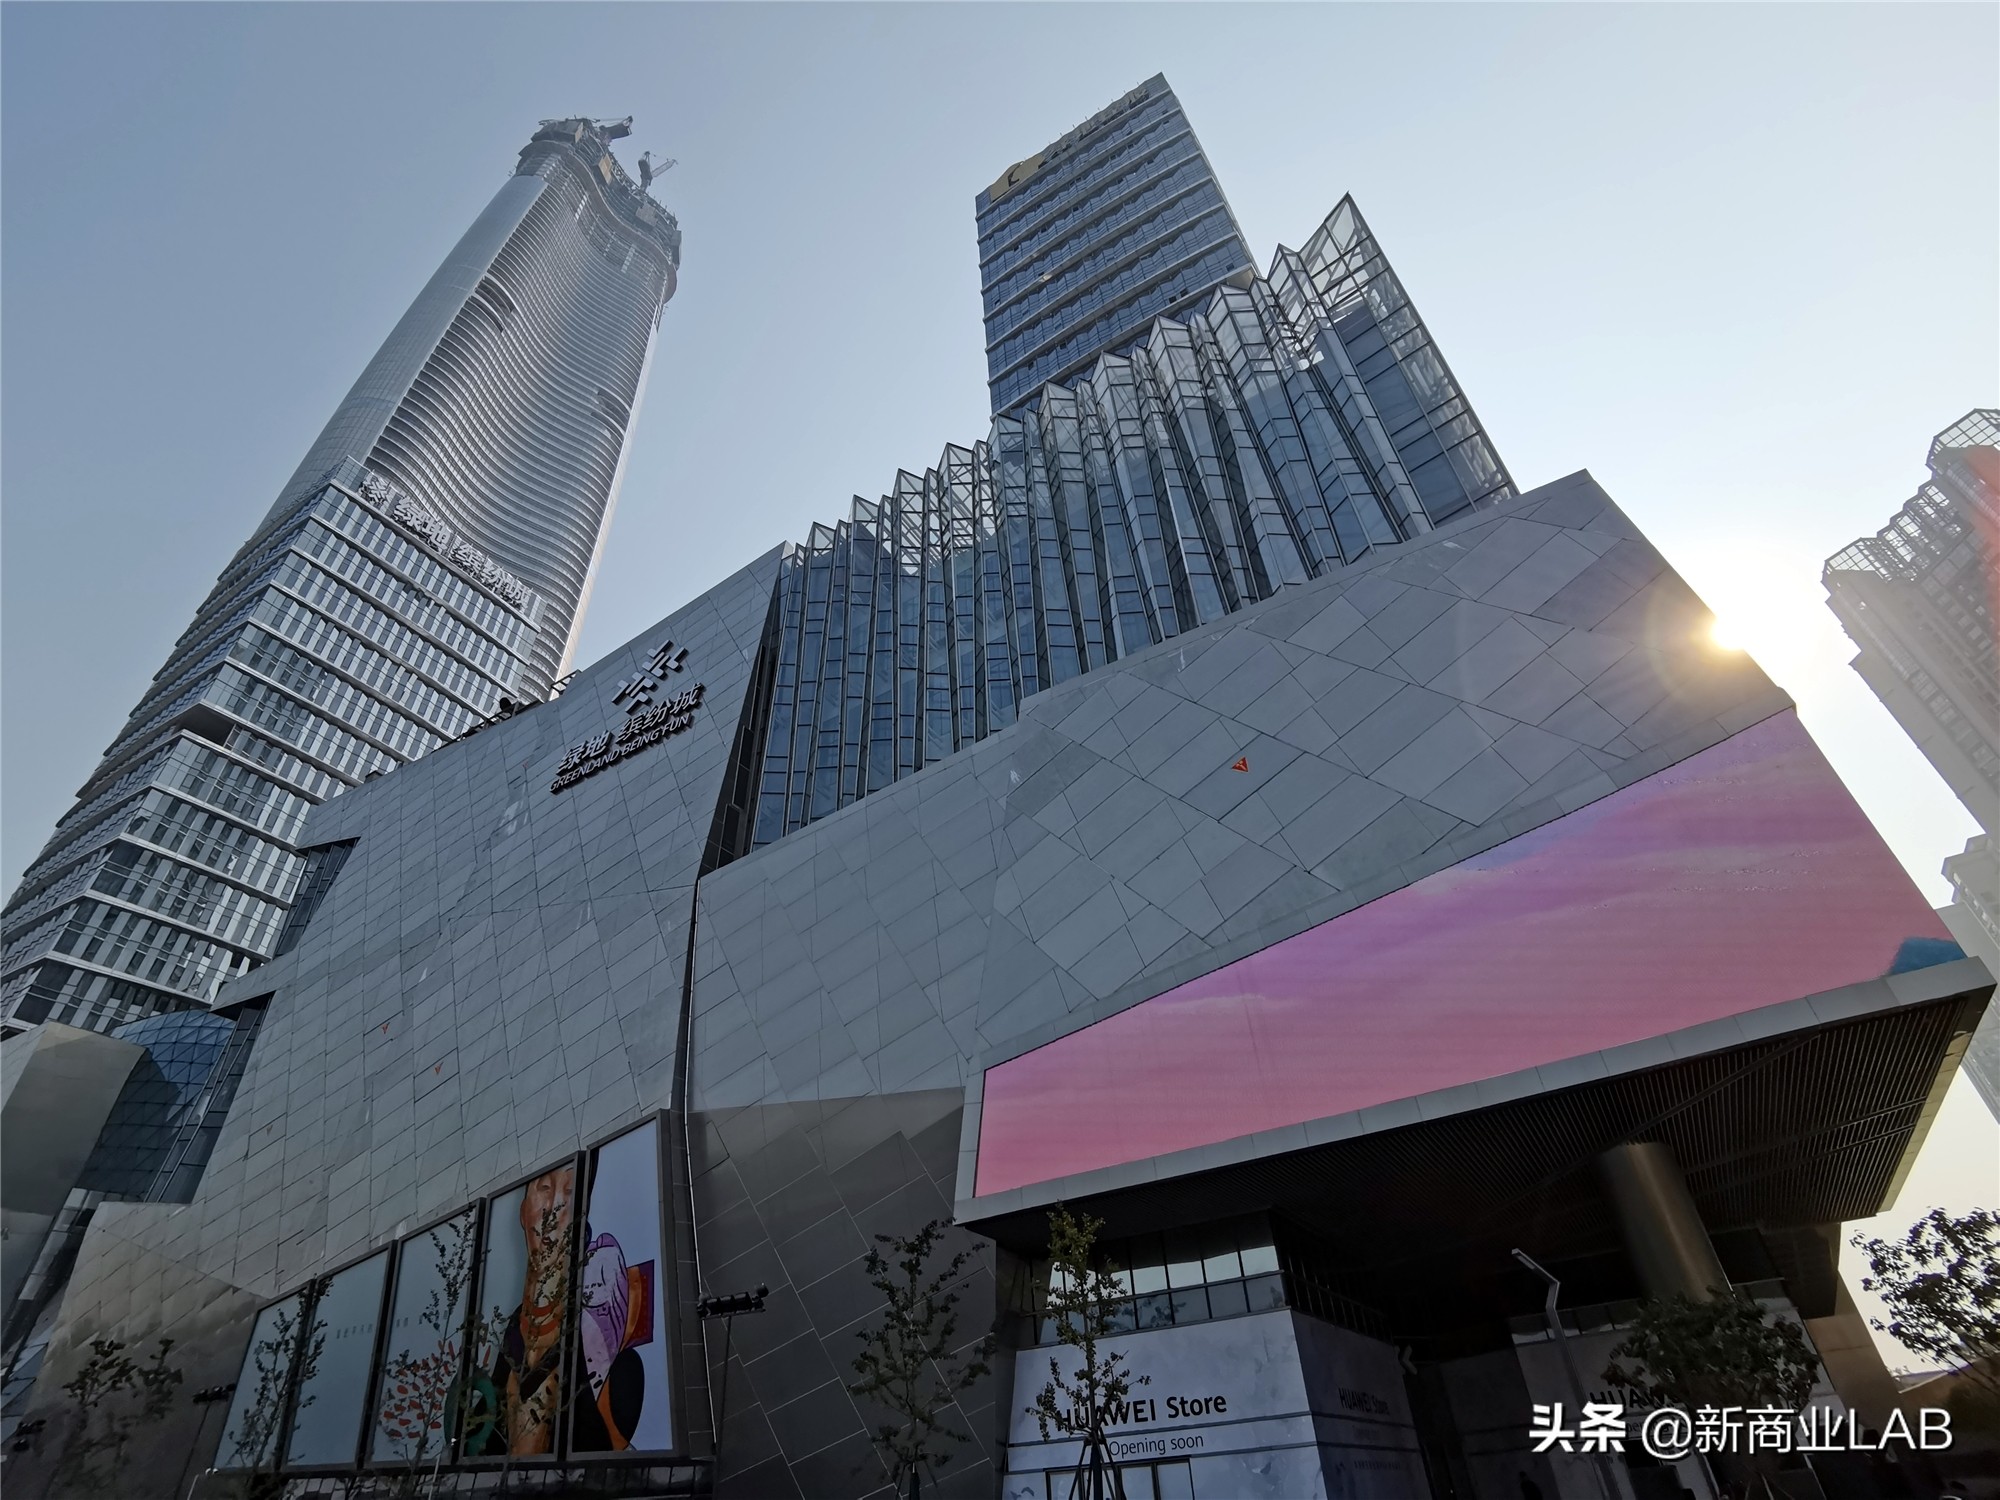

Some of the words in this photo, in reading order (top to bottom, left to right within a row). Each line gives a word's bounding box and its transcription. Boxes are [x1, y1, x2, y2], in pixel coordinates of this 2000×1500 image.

[394, 497, 451, 552] 绿地
[550, 748, 620, 792] GREENLAND
[621, 732, 660, 756] BEING
[662, 714, 691, 735] FUN
[556, 731, 611, 773] 绿地
[615, 683, 704, 741] 缤纷城
[1167, 1392, 1227, 1418] Store
[1109, 1437, 1166, 1459] Opening
[1171, 1433, 1204, 1450] soon
